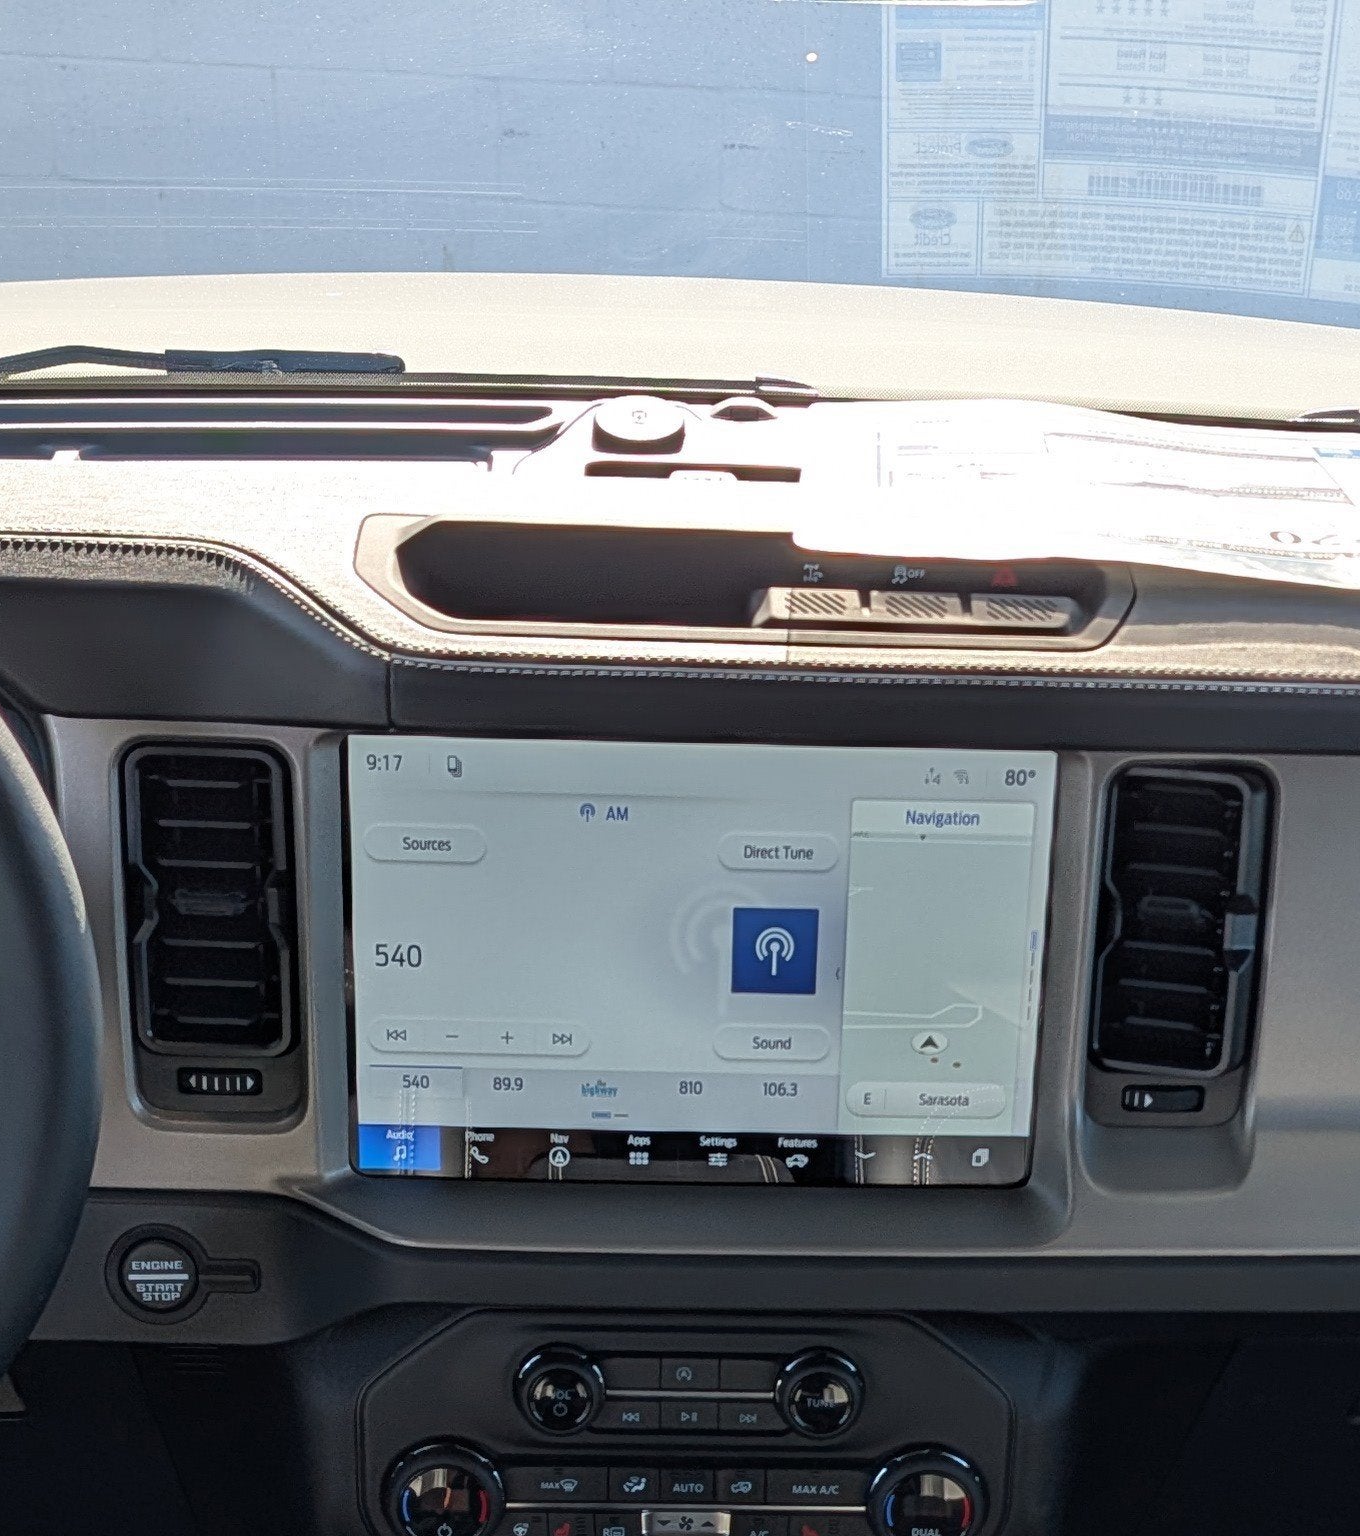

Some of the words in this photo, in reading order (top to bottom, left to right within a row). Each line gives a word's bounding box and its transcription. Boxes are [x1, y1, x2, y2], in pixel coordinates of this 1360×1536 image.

[908, 568, 927, 579] OFF
[365, 753, 404, 774] 9:17
[605, 805, 630, 822] AM
[905, 809, 981, 828] Navigation
[401, 834, 452, 854] Sources
[743, 844, 779, 862] Direct
[782, 844, 815, 862] Tune
[374, 943, 423, 969] 540
[751, 1034, 792, 1053] Sound
[402, 1074, 430, 1090] 540
[492, 1076, 524, 1092] 89.9
[678, 1080, 703, 1096] 810
[762, 1081, 798, 1098] 106.3
[863, 1092, 872, 1106] E
[918, 1092, 970, 1108] Sarasota
[385, 1129, 415, 1141] Audio
[464, 1130, 495, 1143] Phone
[549, 1132, 570, 1144] Nav
[626, 1133, 652, 1147] Apps
[699, 1135, 738, 1150] Settings
[777, 1136, 818, 1149] Features
[131, 1261, 183, 1270] ENGINE
[136, 1283, 184, 1292] START
[142, 1292, 181, 1301] STOP
[540, 1481, 560, 1491] MAX
[673, 1483, 704, 1494] AUTO
[792, 1484, 817, 1495] MAX
[818, 1484, 840, 1496] A/C
